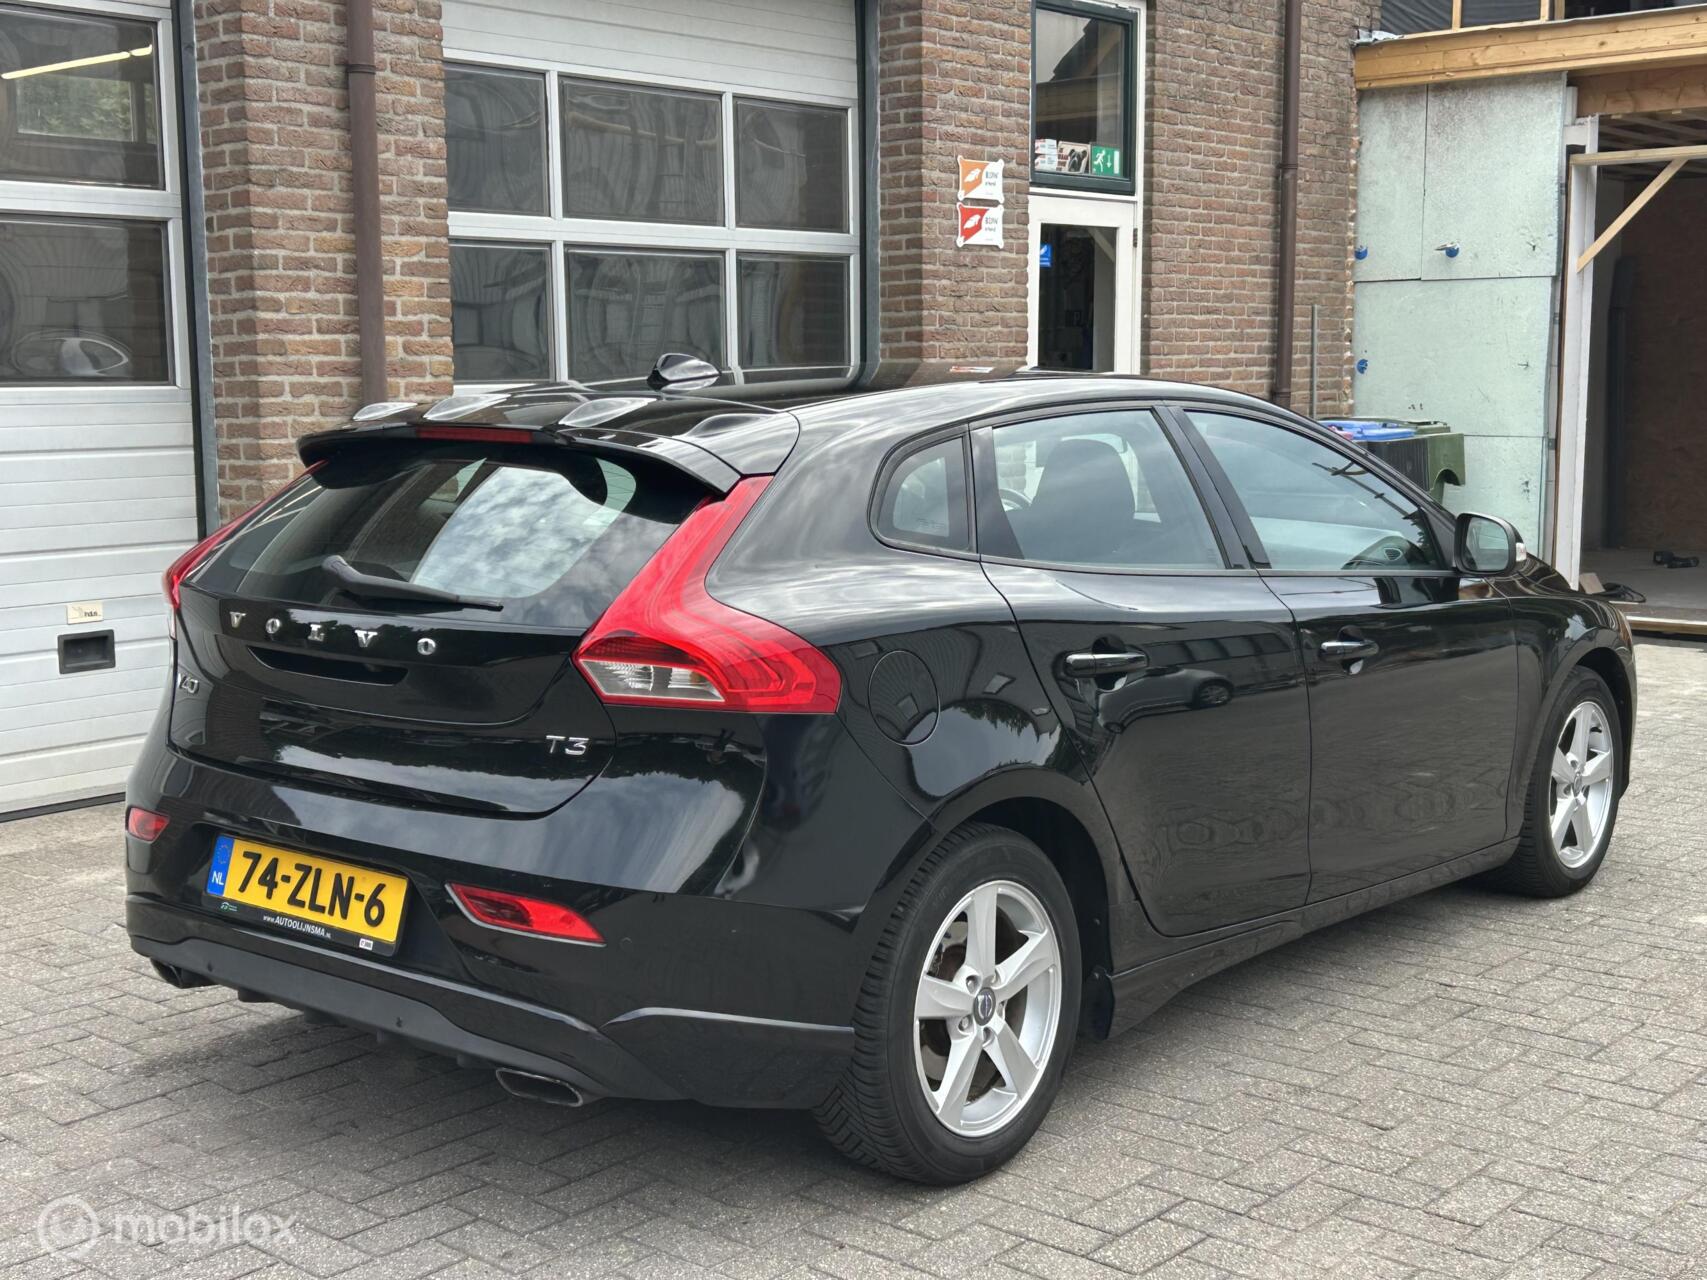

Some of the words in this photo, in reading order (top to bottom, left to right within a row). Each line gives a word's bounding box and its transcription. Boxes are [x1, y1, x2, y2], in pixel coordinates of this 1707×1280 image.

[229, 611, 438, 656] VOLVO
[545, 734, 590, 756] T3
[211, 870, 224, 887] NL
[238, 850, 387, 928] 74-ZLN-6
